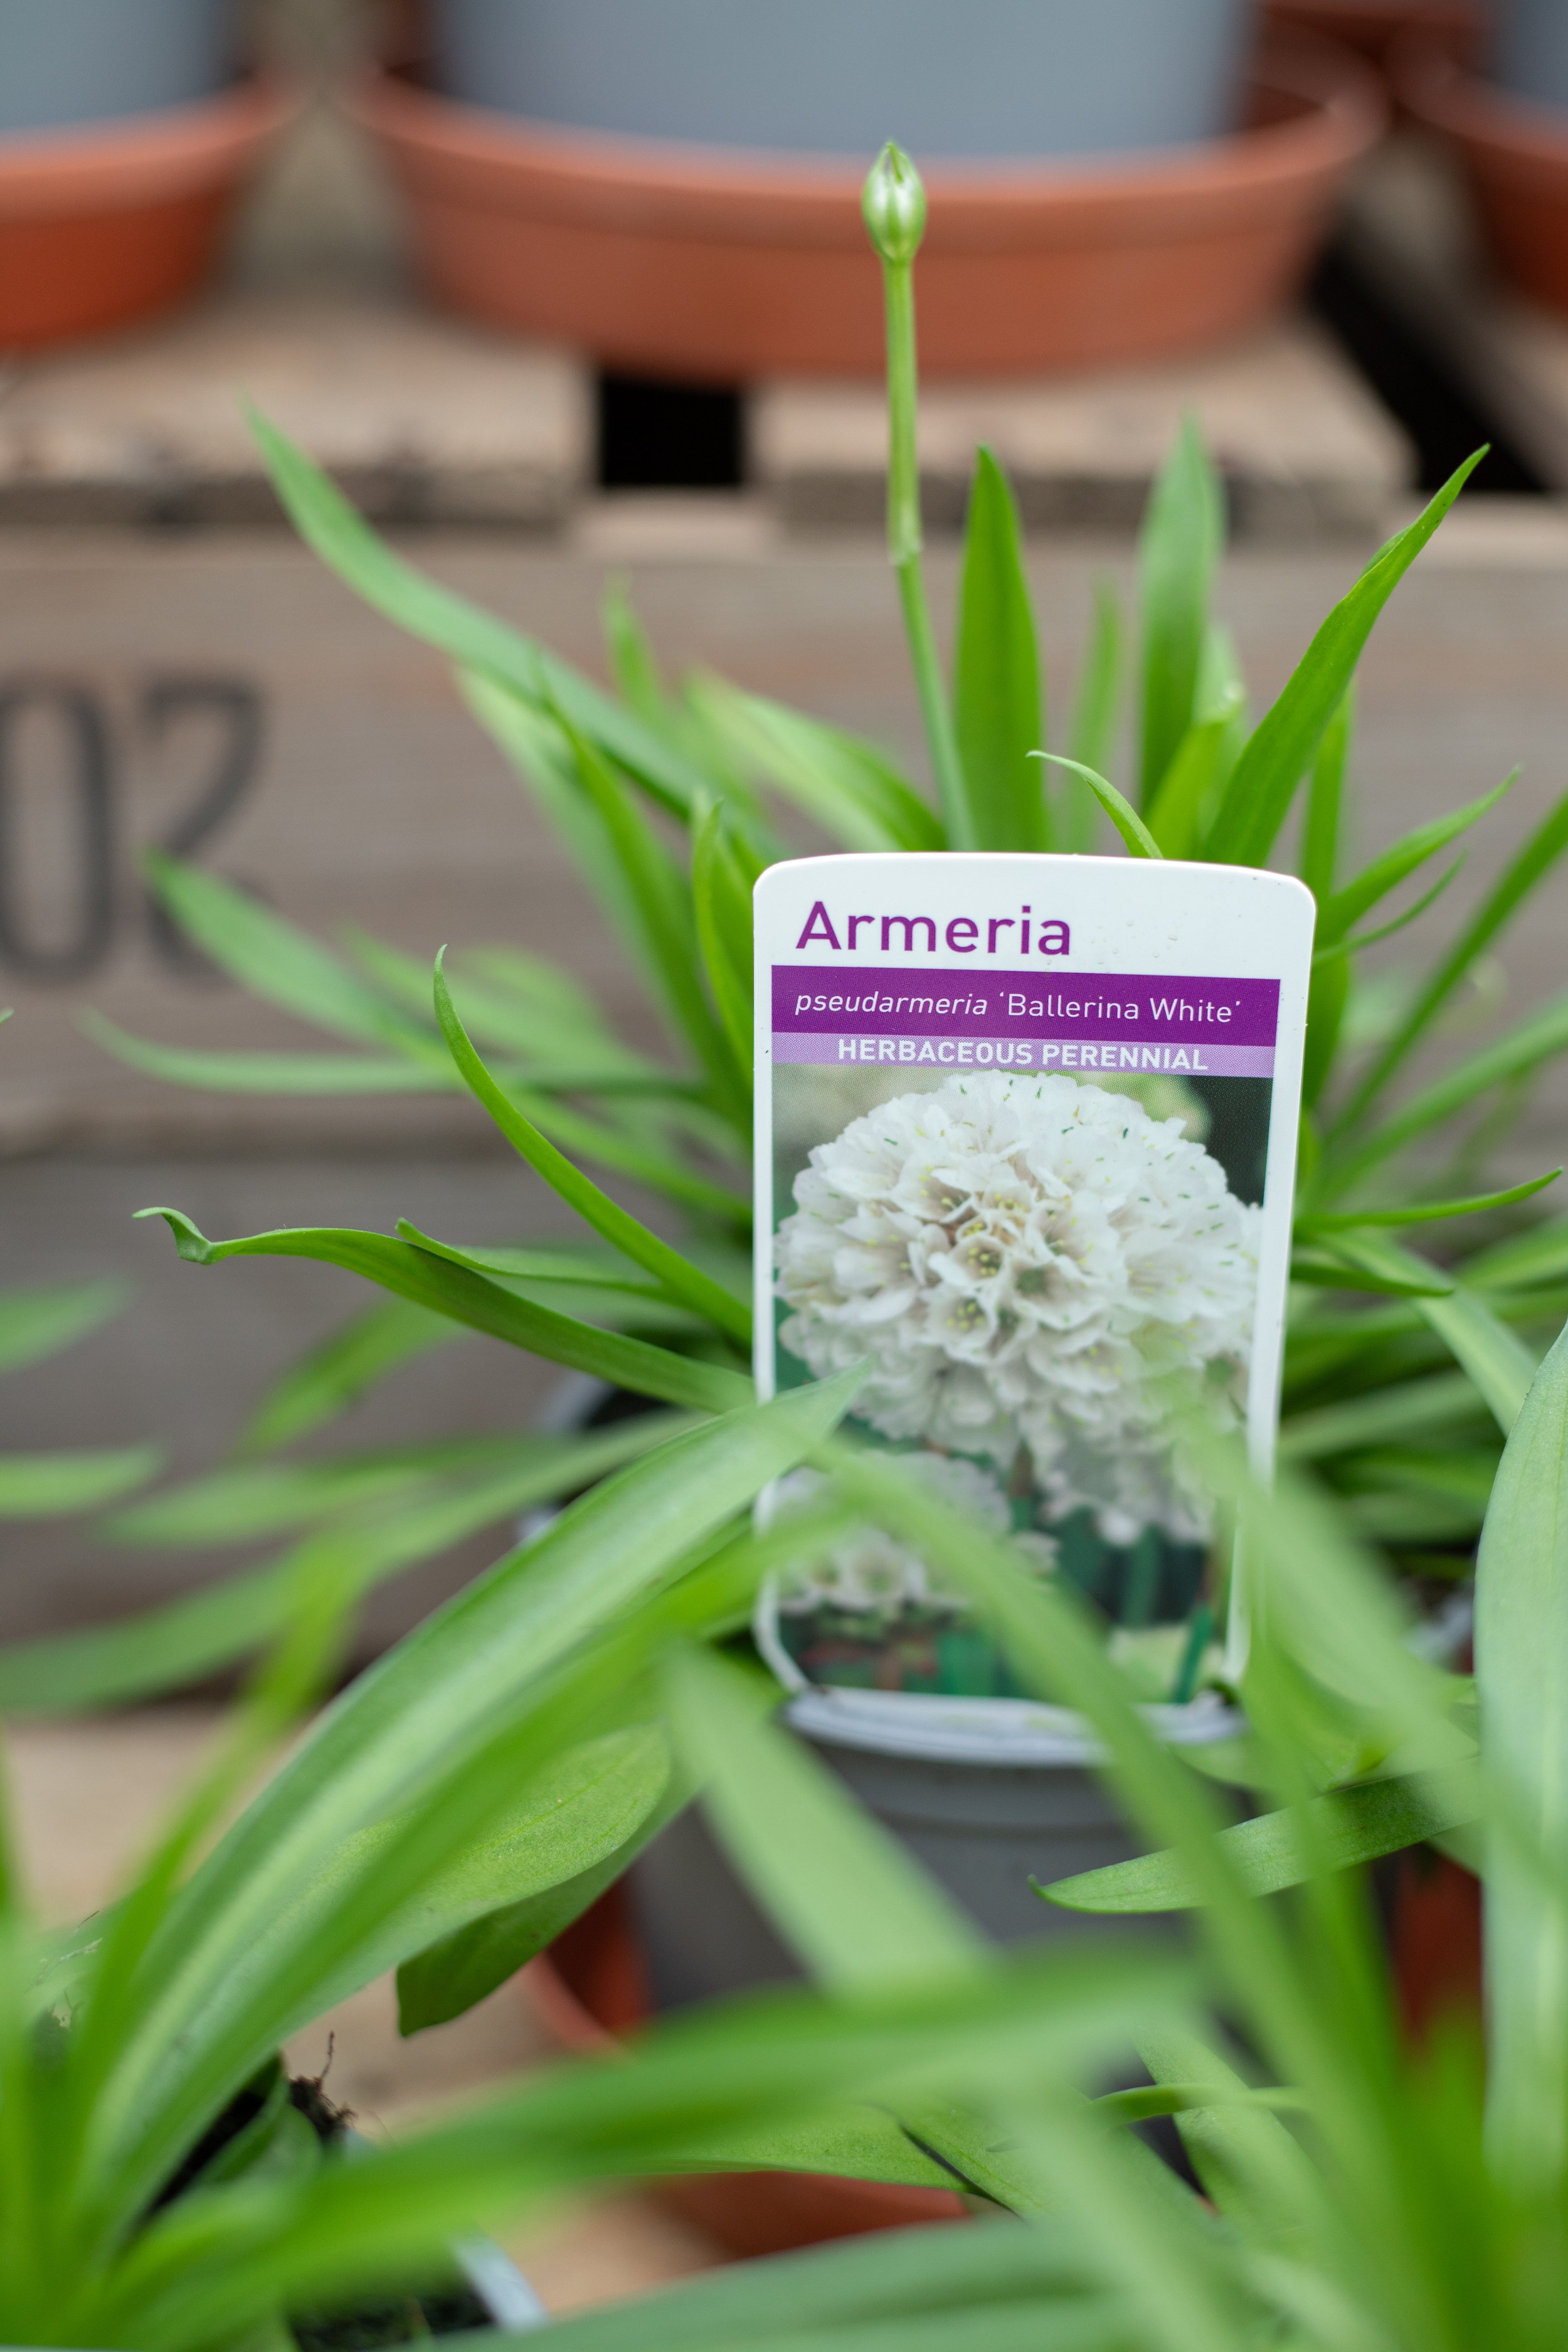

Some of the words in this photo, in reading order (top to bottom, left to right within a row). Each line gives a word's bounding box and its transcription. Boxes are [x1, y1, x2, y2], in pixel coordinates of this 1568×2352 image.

[795, 900, 1071, 956] Armeria
[795, 991, 988, 1016] pseudarmeria
[838, 1039, 1034, 1064] HERBACEOUS
[1042, 1044, 1209, 1071] PERENNIAL
